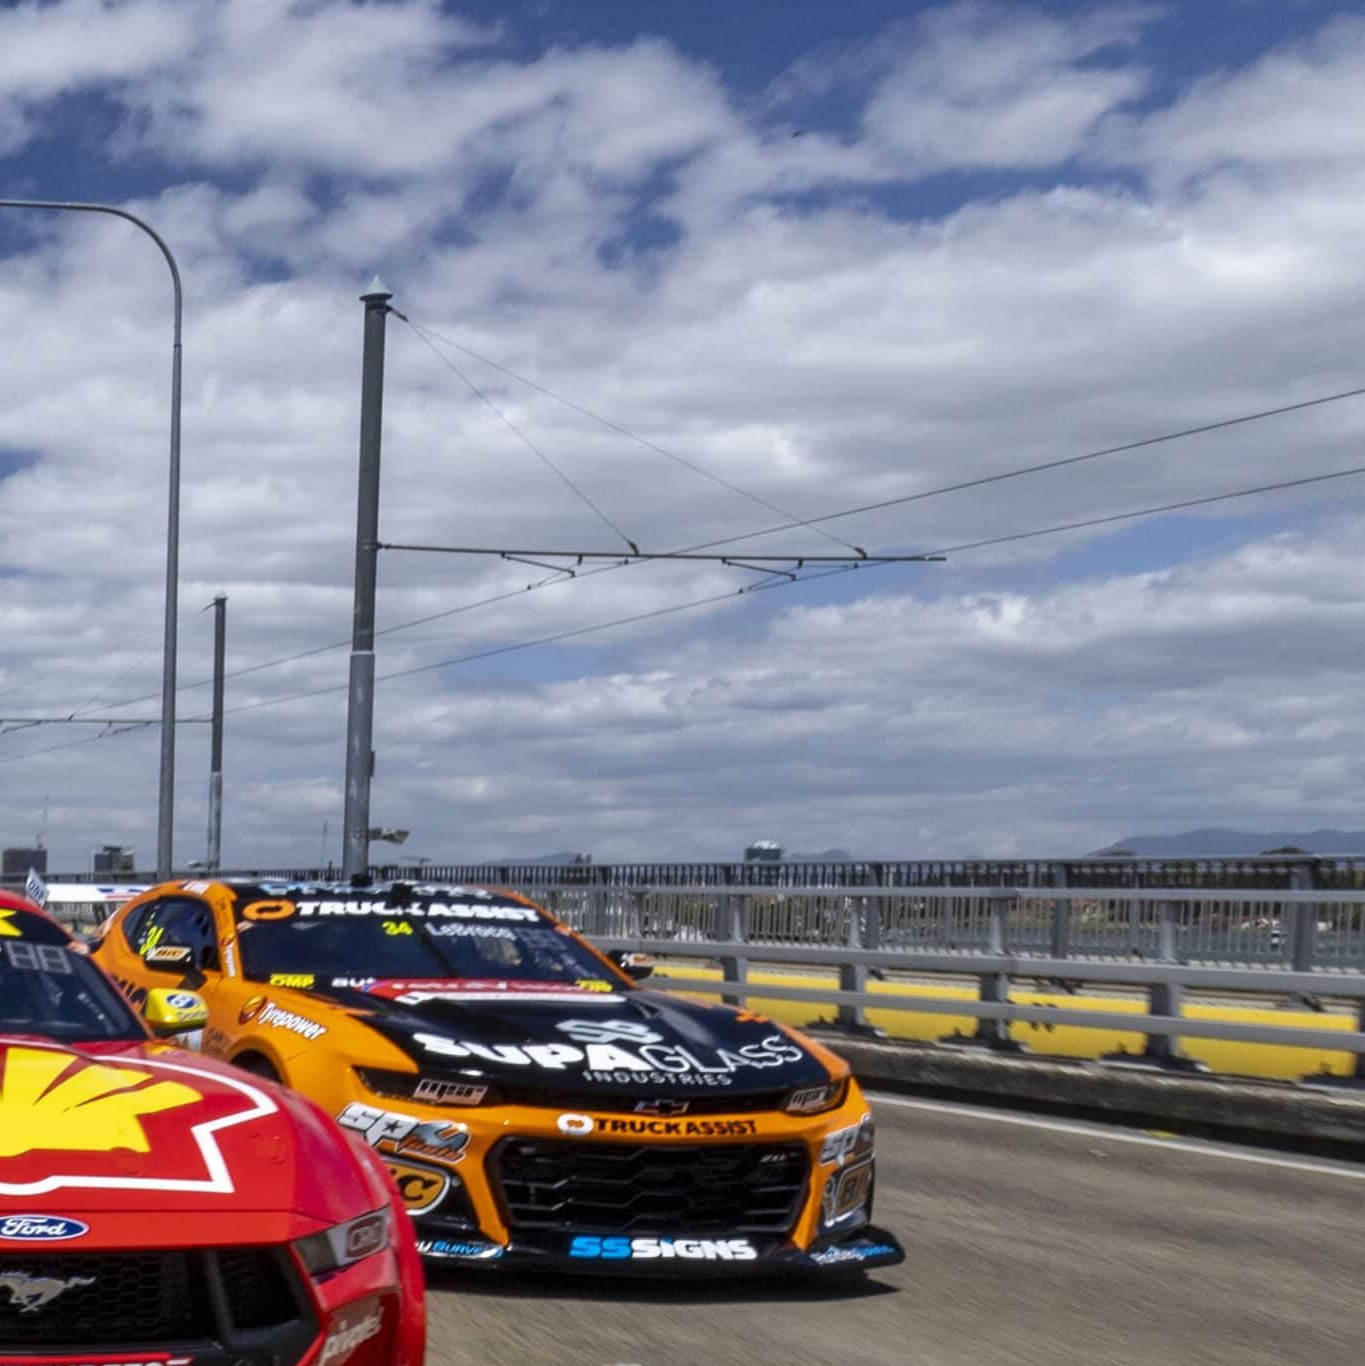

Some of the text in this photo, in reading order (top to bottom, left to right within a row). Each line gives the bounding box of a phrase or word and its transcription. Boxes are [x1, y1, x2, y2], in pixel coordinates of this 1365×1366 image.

[295, 901, 540, 922] TRUCK ASSIST
[381, 921, 413, 937] 34
[257, 1001, 328, 1041] Tyrepower
[583, 1070, 733, 1087] INDUSTRIES
[596, 1117, 757, 1136] TRUCK ASSIST
[0, 1216, 67, 1238] Ford
